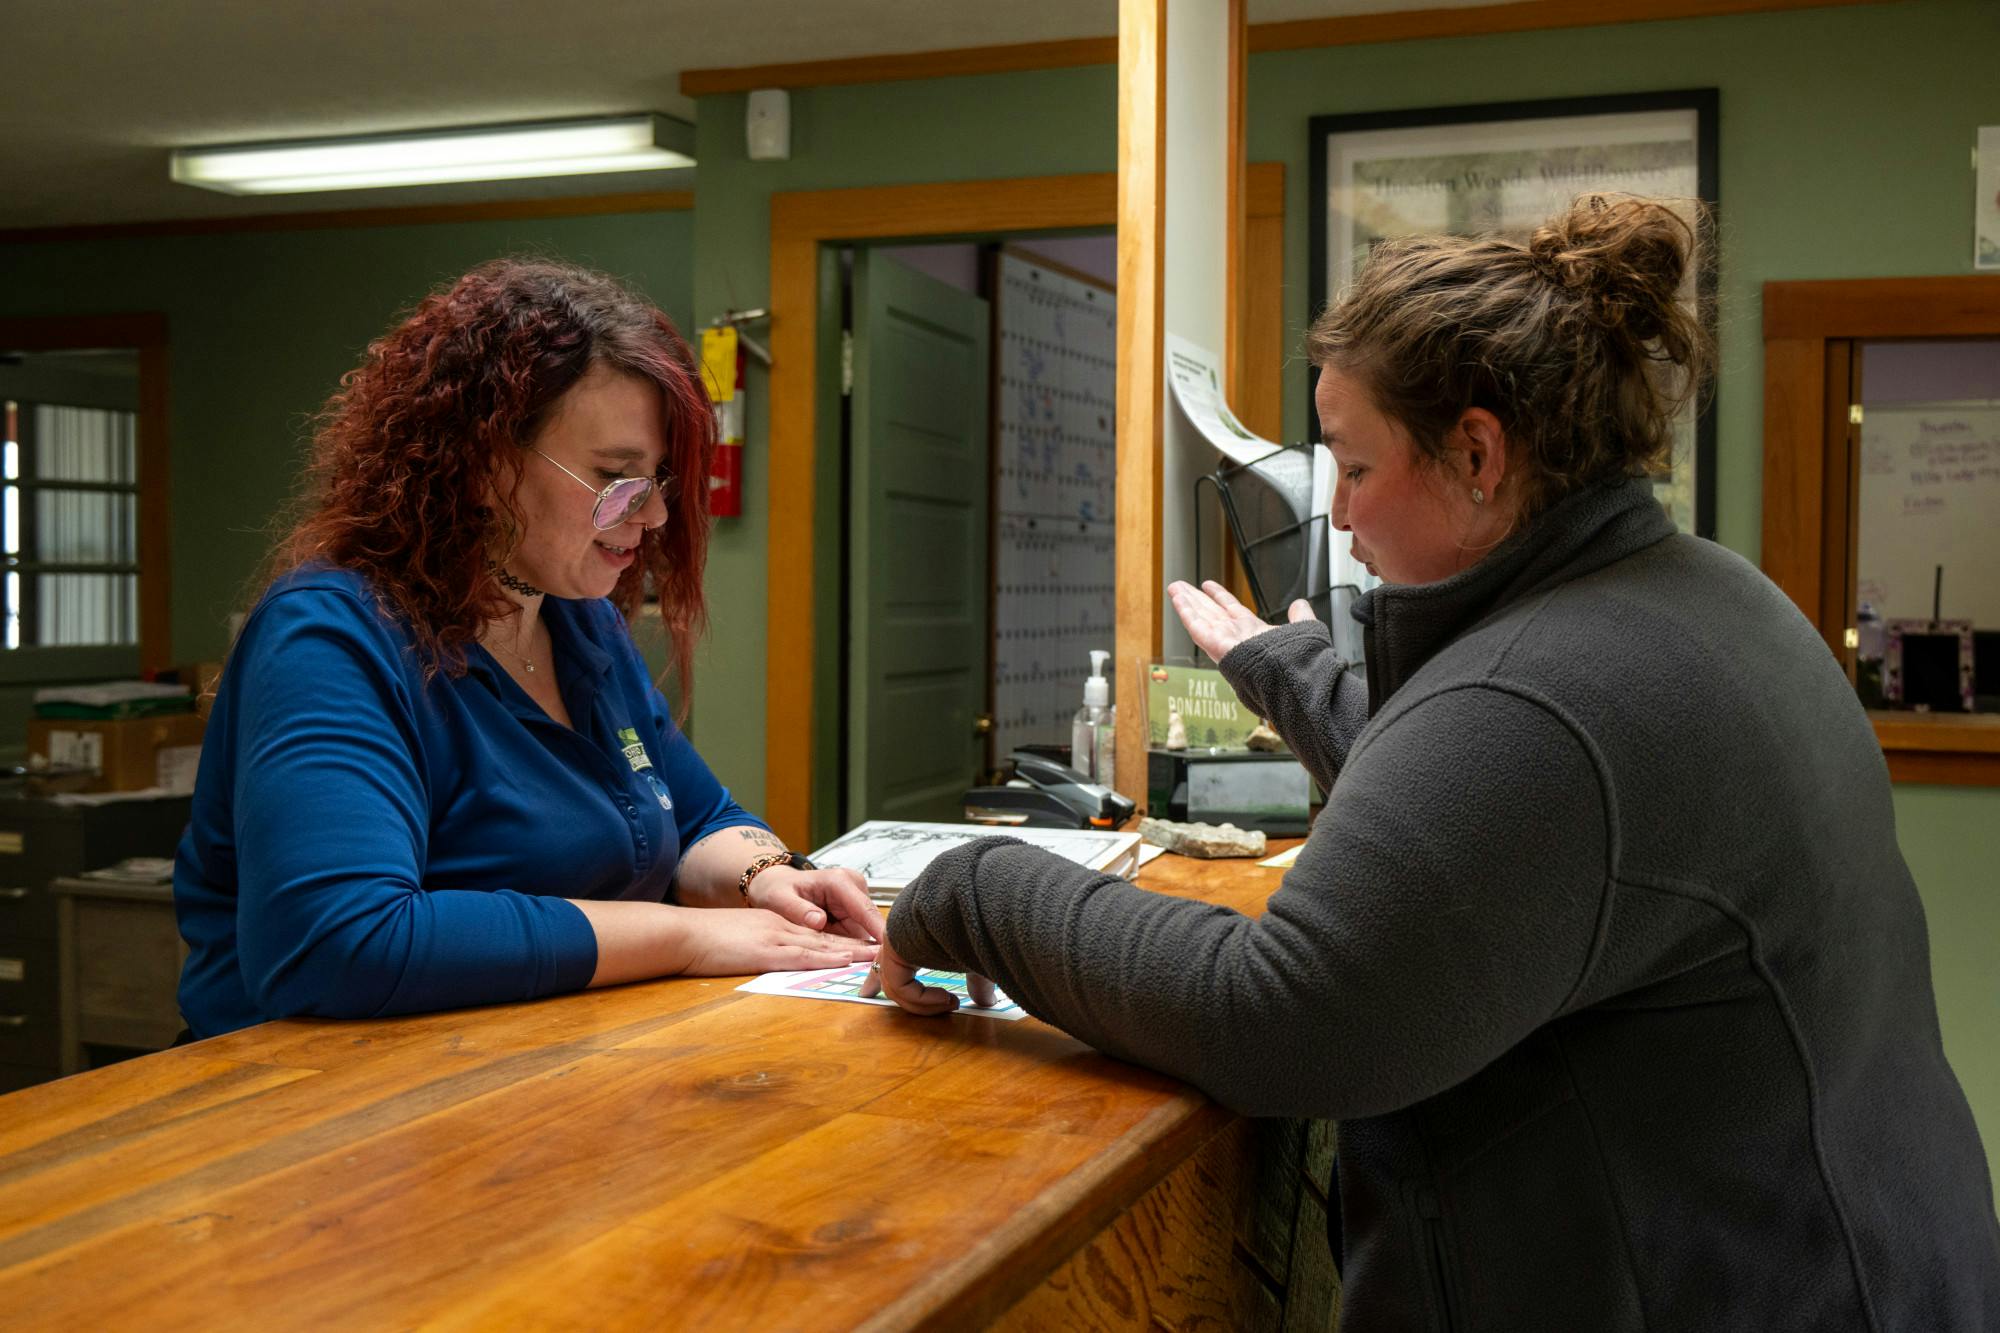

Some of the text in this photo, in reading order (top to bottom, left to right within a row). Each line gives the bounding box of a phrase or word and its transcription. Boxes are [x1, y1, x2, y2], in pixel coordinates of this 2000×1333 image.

[1463, 167, 1529, 192] Woods
[1539, 161, 1668, 184] Wildflowers
[1187, 678, 1218, 699] PARK
[1168, 695, 1238, 721] DONATIONS
